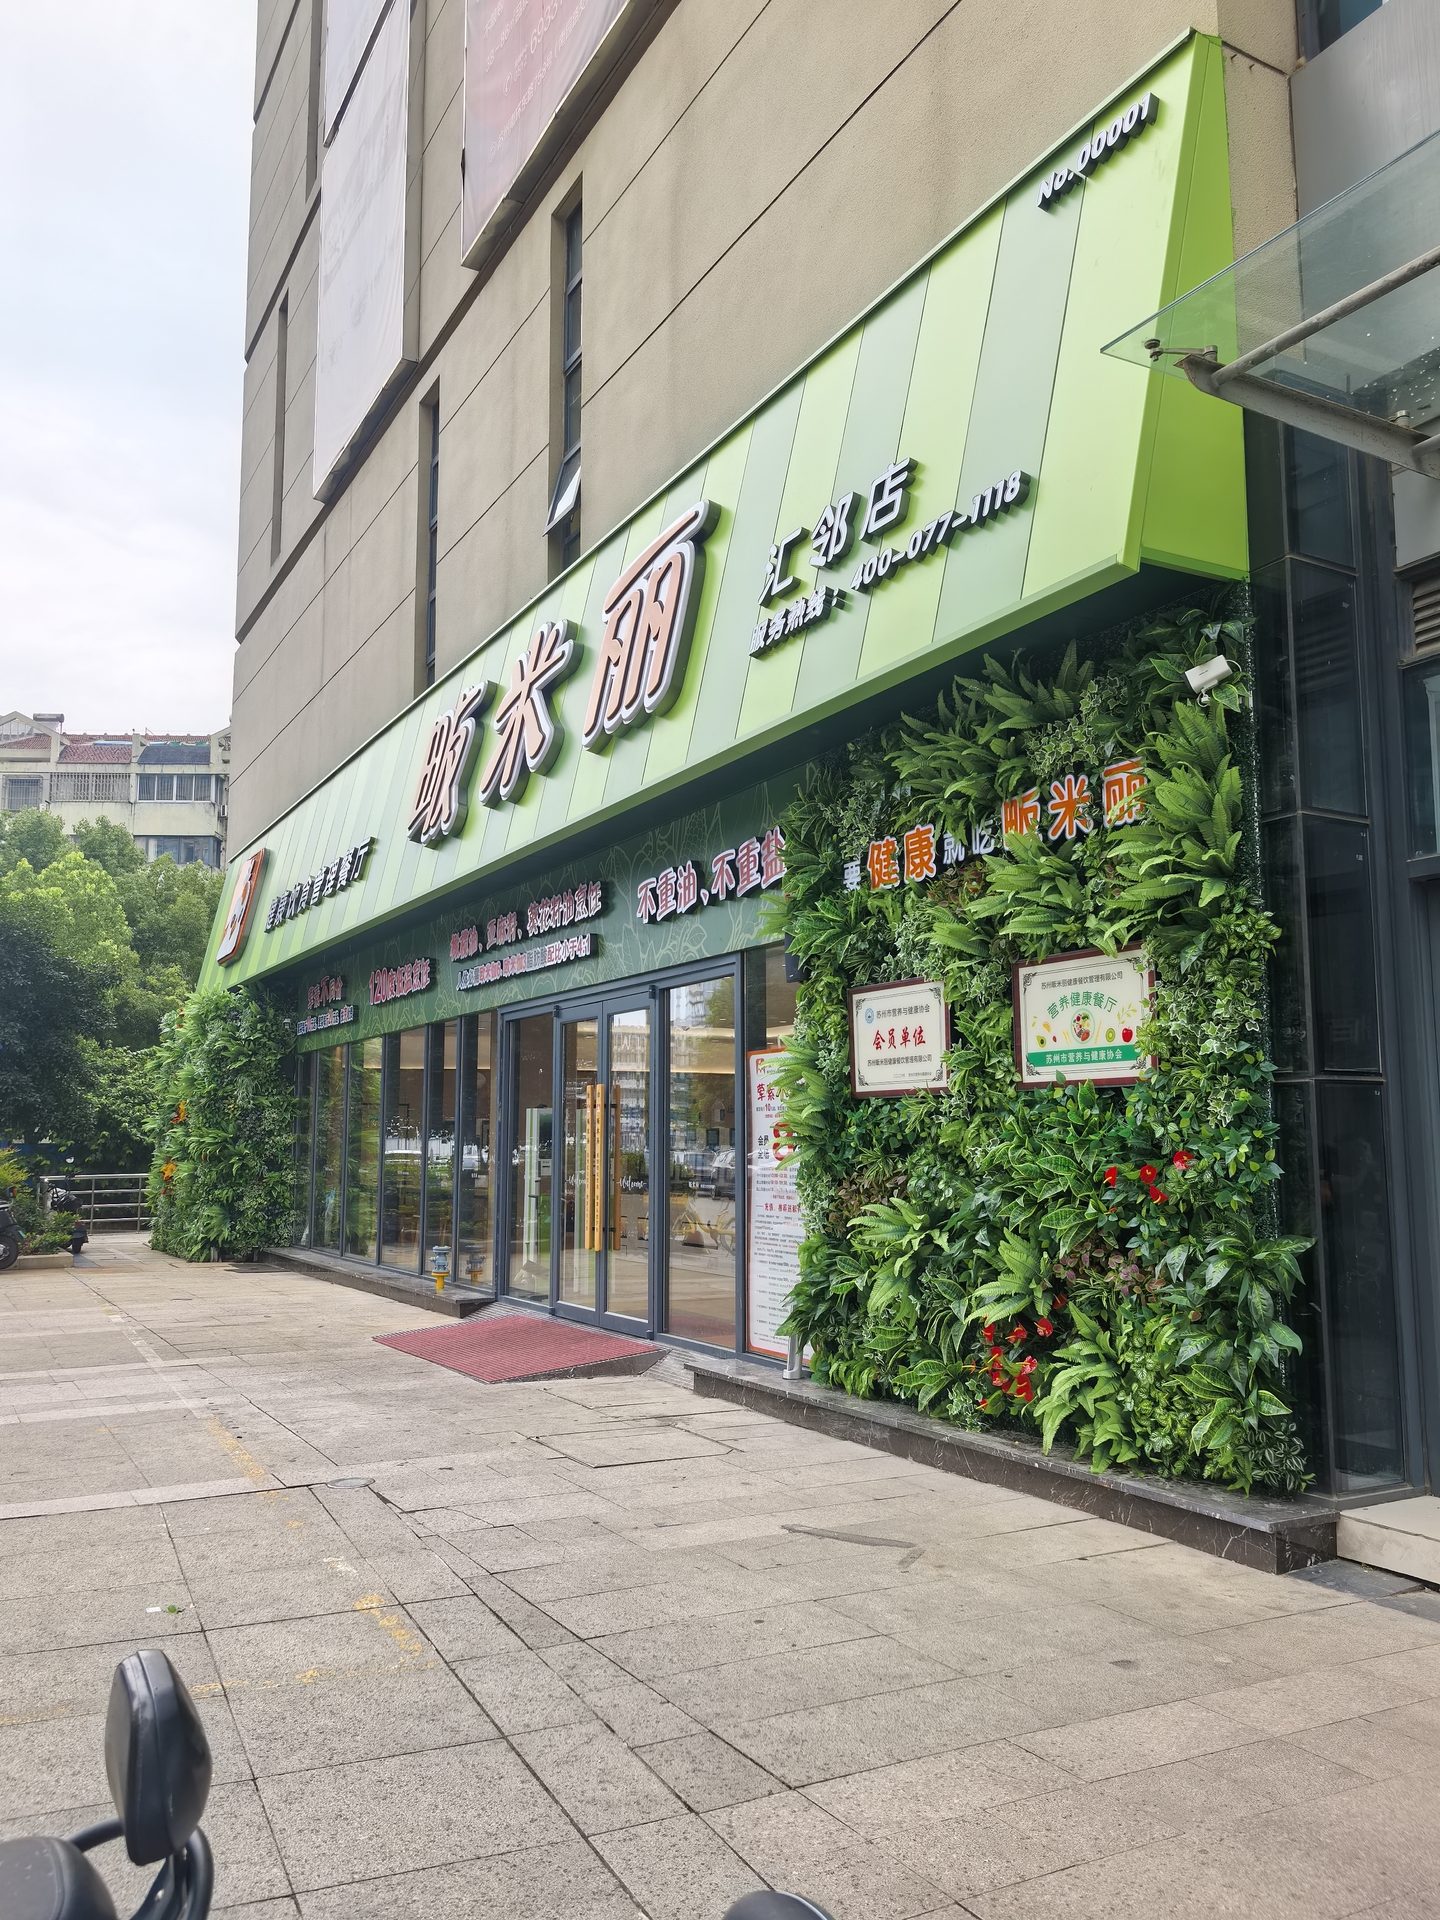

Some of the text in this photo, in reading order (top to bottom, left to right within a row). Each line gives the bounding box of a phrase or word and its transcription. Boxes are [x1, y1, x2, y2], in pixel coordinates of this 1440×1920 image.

[1037, 91, 1154, 208] No.00001
[758, 457, 914, 608] 汇邻店
[264, 836, 377, 933] 健康饮食管理餐厅
[368, 957, 431, 1006] 120度低温烹饪
[876, 1003, 931, 1019] 苏州市营养与健康协会
[1046, 990, 1118, 1019] 营养健康餐厅
[872, 1025, 926, 1051] 会员单位
[1045, 1048, 1123, 1065] 苏州市营养与健康协会
